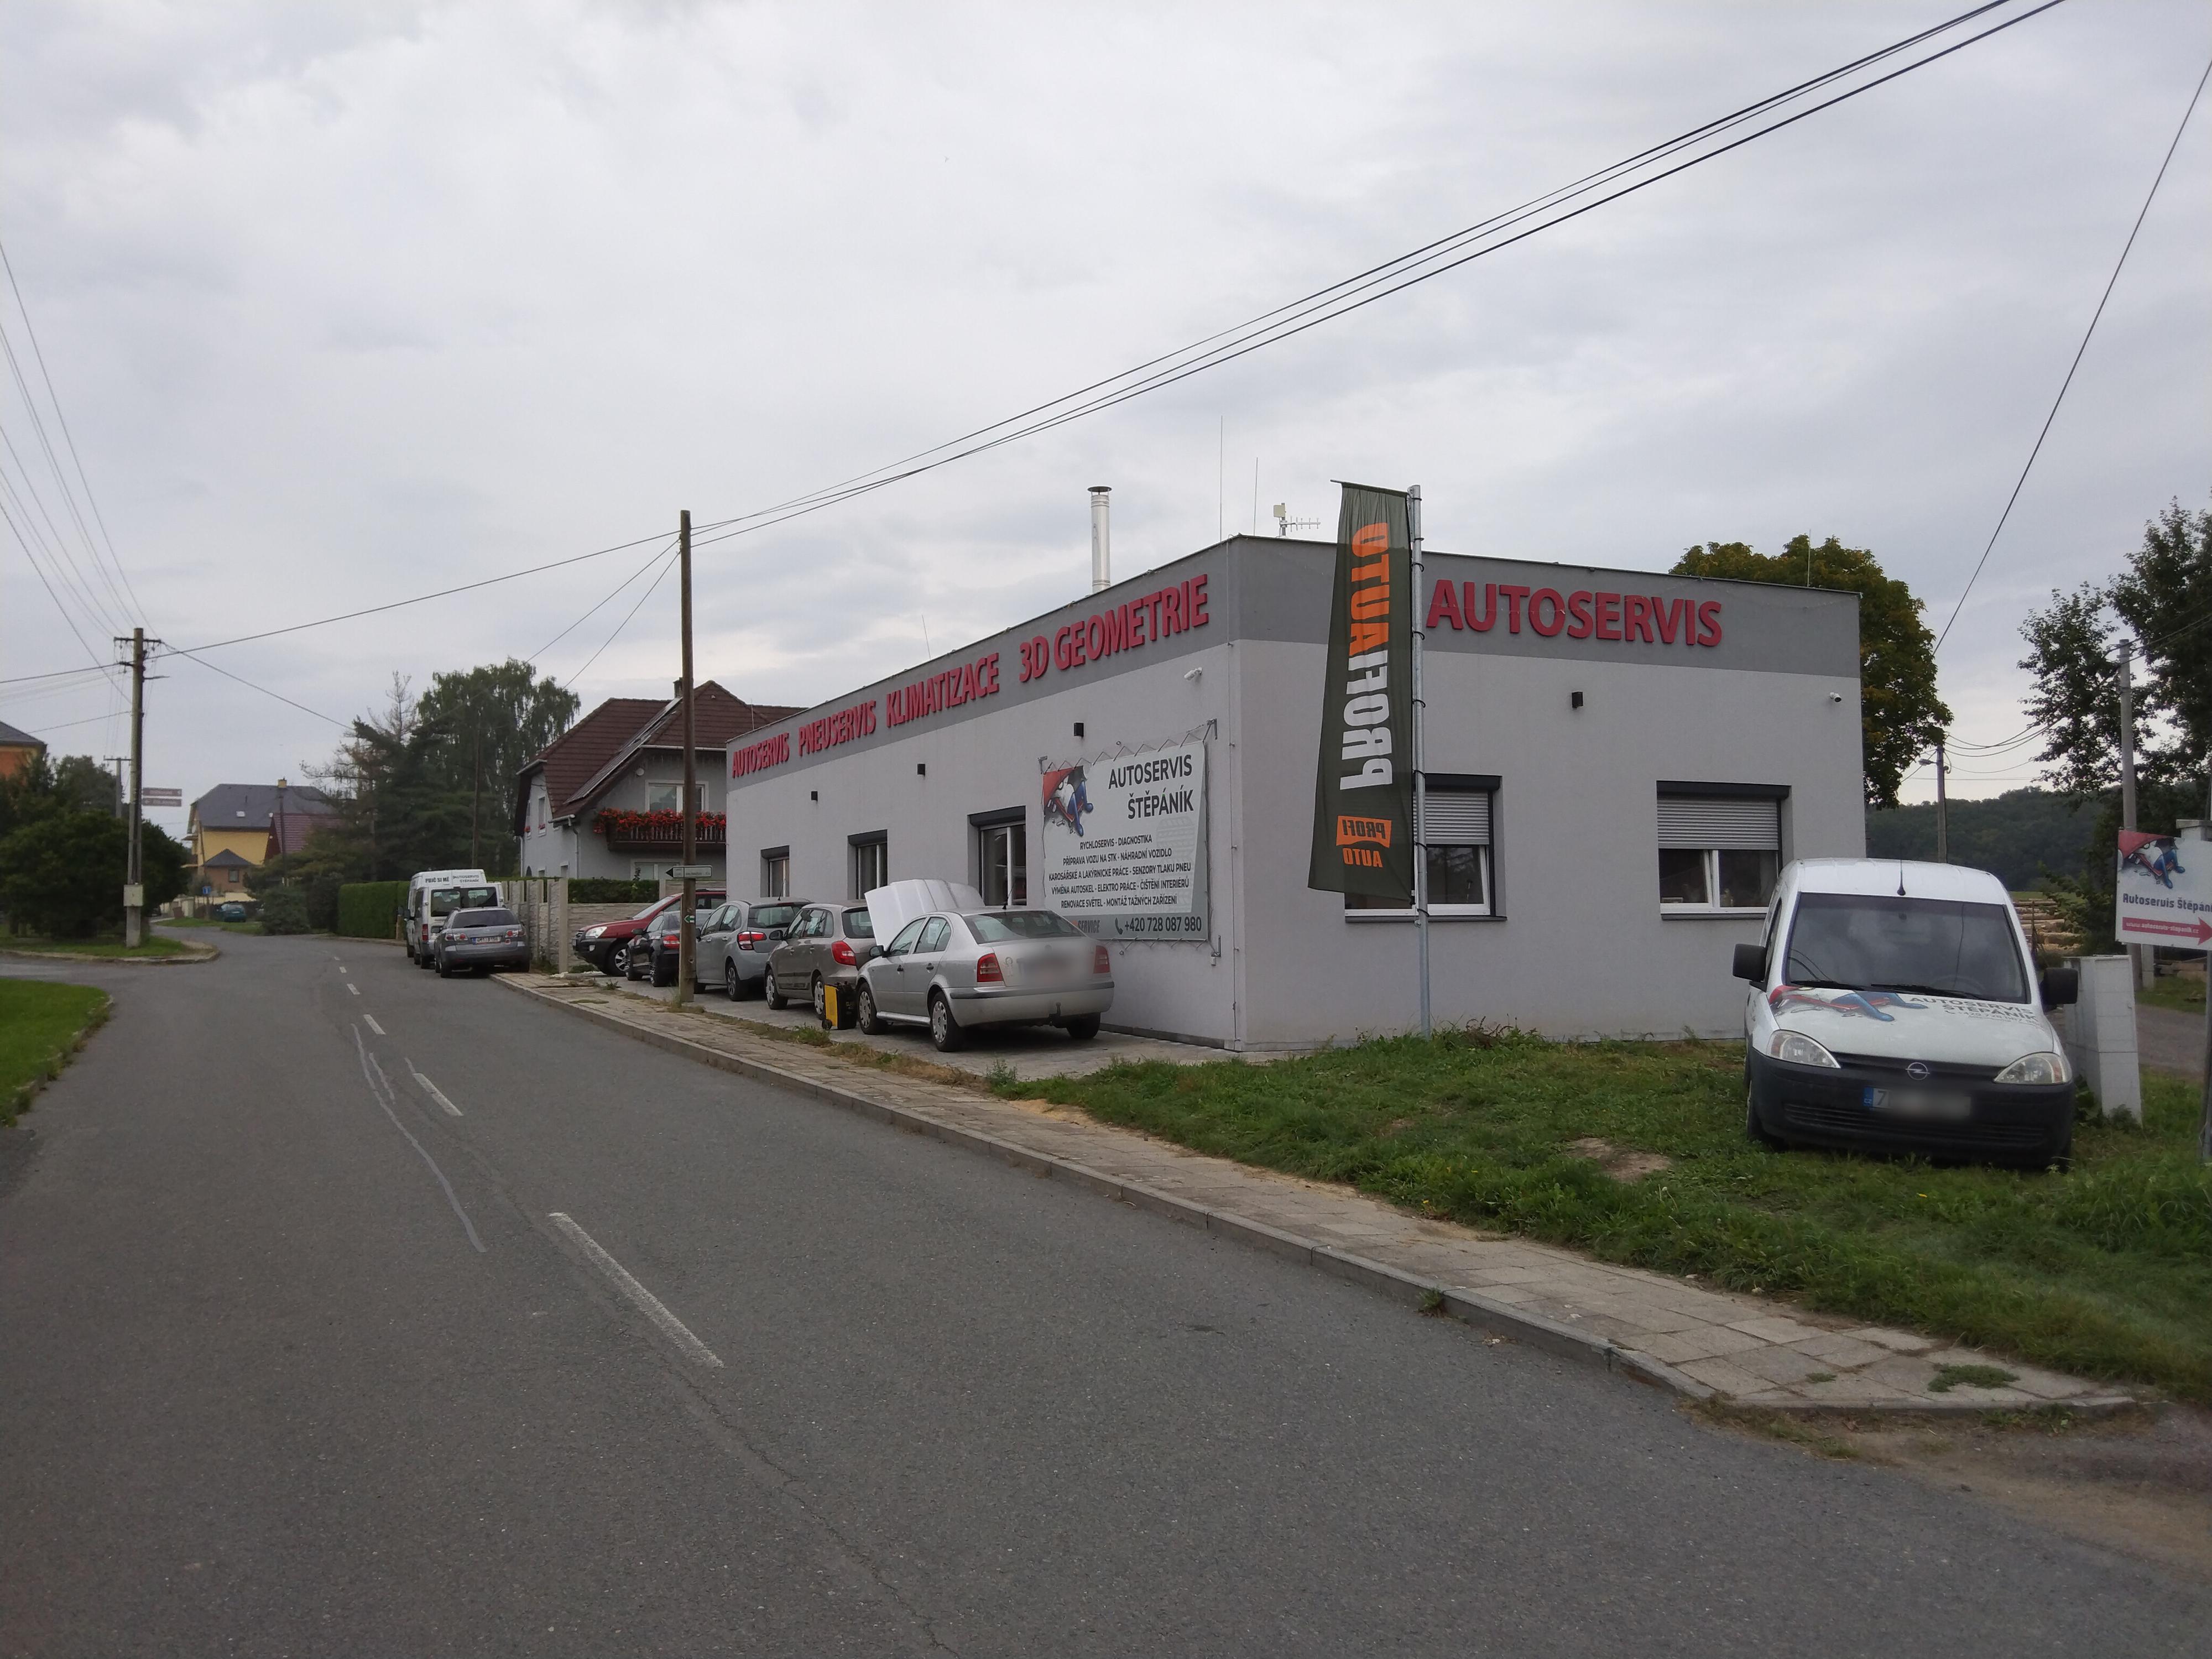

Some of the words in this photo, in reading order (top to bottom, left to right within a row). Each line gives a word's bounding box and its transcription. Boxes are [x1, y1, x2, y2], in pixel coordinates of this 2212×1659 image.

[1426, 579, 1722, 647] AUTOSERVIS
[732, 732, 790, 778] AUTOSERVIS
[798, 700, 877, 756] PNEUSERVIS
[886, 652, 999, 727] KLIMATIZACE
[1019, 635, 1049, 682] 3D
[1053, 573, 1209, 670] GEOMETRIE
[1108, 754, 1192, 790] AUTOSERVIS
[1127, 785, 1194, 819] ŠTĚPÁNÍK
[1080, 838, 1114, 850] RYCHLOSERVIS
[1118, 834, 1152, 846] DIAGNOSTIKA
[1063, 855, 1086, 866] PŘÍPRAVA
[1086, 854, 1099, 864] VOZU
[1100, 854, 1107, 862] NA
[1108, 853, 1117, 862] STK
[1120, 848, 1147, 860] NÁHRADNÍ
[1149, 848, 1172, 858] VOZIDLO
[1048, 869, 1078, 881] KAROSÁŘSKÉ
[1083, 867, 1111, 879] LAKÝRNICKÉ
[1112, 865, 1128, 876] PRÁCE
[1132, 864, 1156, 875] SENZORY
[1157, 863, 1175, 873] TLAKU
[1176, 863, 1191, 872] PNEU
[1051, 884, 1070, 895] VÝMĚNA
[1071, 884, 1094, 894] AUTOSKEL
[1098, 883, 1119, 892] ELEKTRO
[1120, 880, 1136, 891] PRÁCE
[1140, 878, 1160, 890] ČIŠTĚNÍ
[1161, 876, 1189, 889] INTERIÉRŮ
[1061, 899, 1086, 909] RENOVACE
[1086, 897, 1103, 907] SVĚTEL
[1107, 895, 1127, 907] MONTÁŽ
[1128, 895, 1151, 906] TAŽNÝCH
[1152, 893, 1177, 905] ZAŘÍZENÍ
[2123, 893, 2174, 908] Autoservis
[1078, 920, 1100, 933] SERVICE
[1124, 917, 1145, 932] +420
[1147, 917, 1164, 932] 728
[1166, 917, 1182, 932] 087
[1185, 916, 1202, 931] 980
[1910, 997, 2033, 1015] AUTOSERVIS
[1942, 1004, 2038, 1022] ŠTĚPÁNÍK
